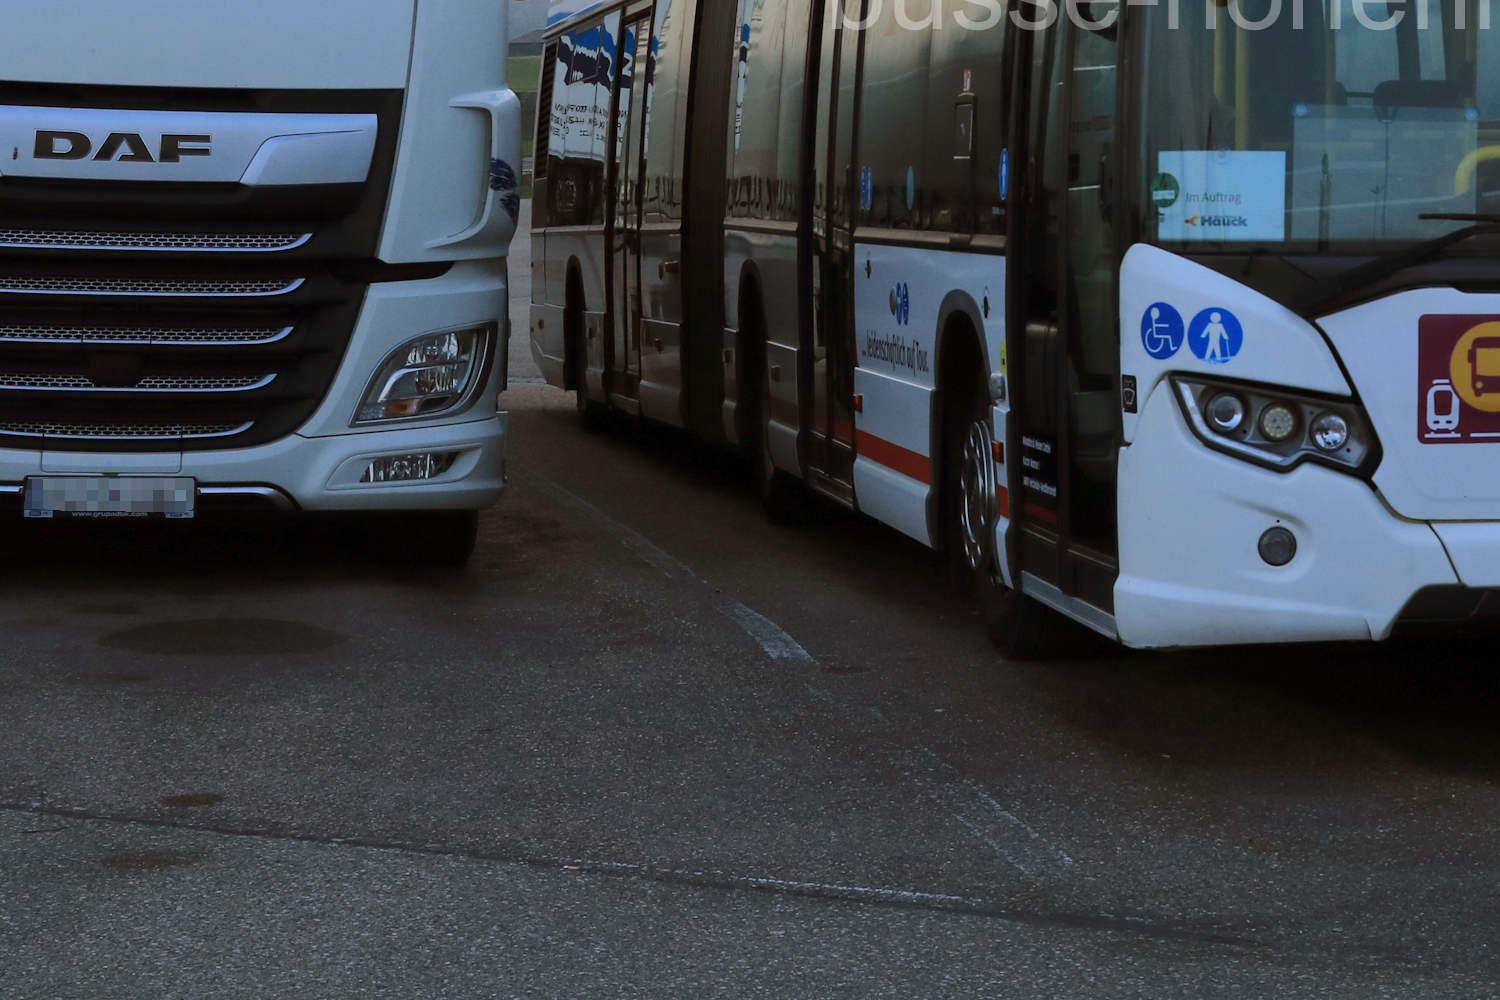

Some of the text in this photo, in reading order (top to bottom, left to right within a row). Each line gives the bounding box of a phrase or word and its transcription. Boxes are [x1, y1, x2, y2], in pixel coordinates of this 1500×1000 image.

[33, 129, 212, 163] DAF
[1186, 192, 1199, 202] Im
[1202, 192, 1241, 205] Auftrag
